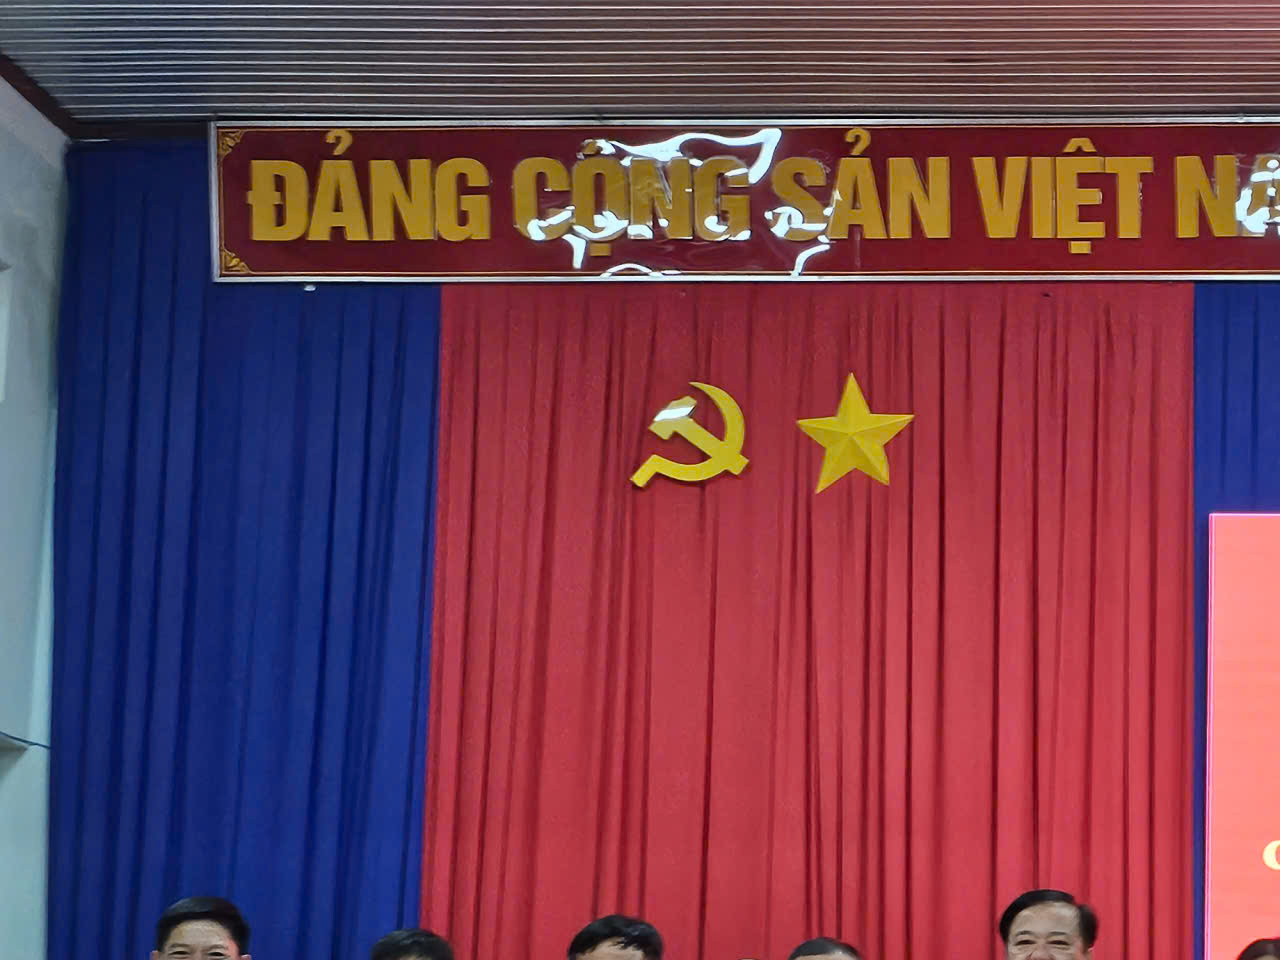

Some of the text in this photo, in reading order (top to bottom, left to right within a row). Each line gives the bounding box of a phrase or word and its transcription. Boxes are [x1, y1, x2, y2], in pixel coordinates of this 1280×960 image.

[246, 129, 491, 243] ĐẢNG
[512, 138, 751, 257] CỘNG
[769, 127, 951, 242] SẢN
[972, 138, 1153, 254] VIỆT
